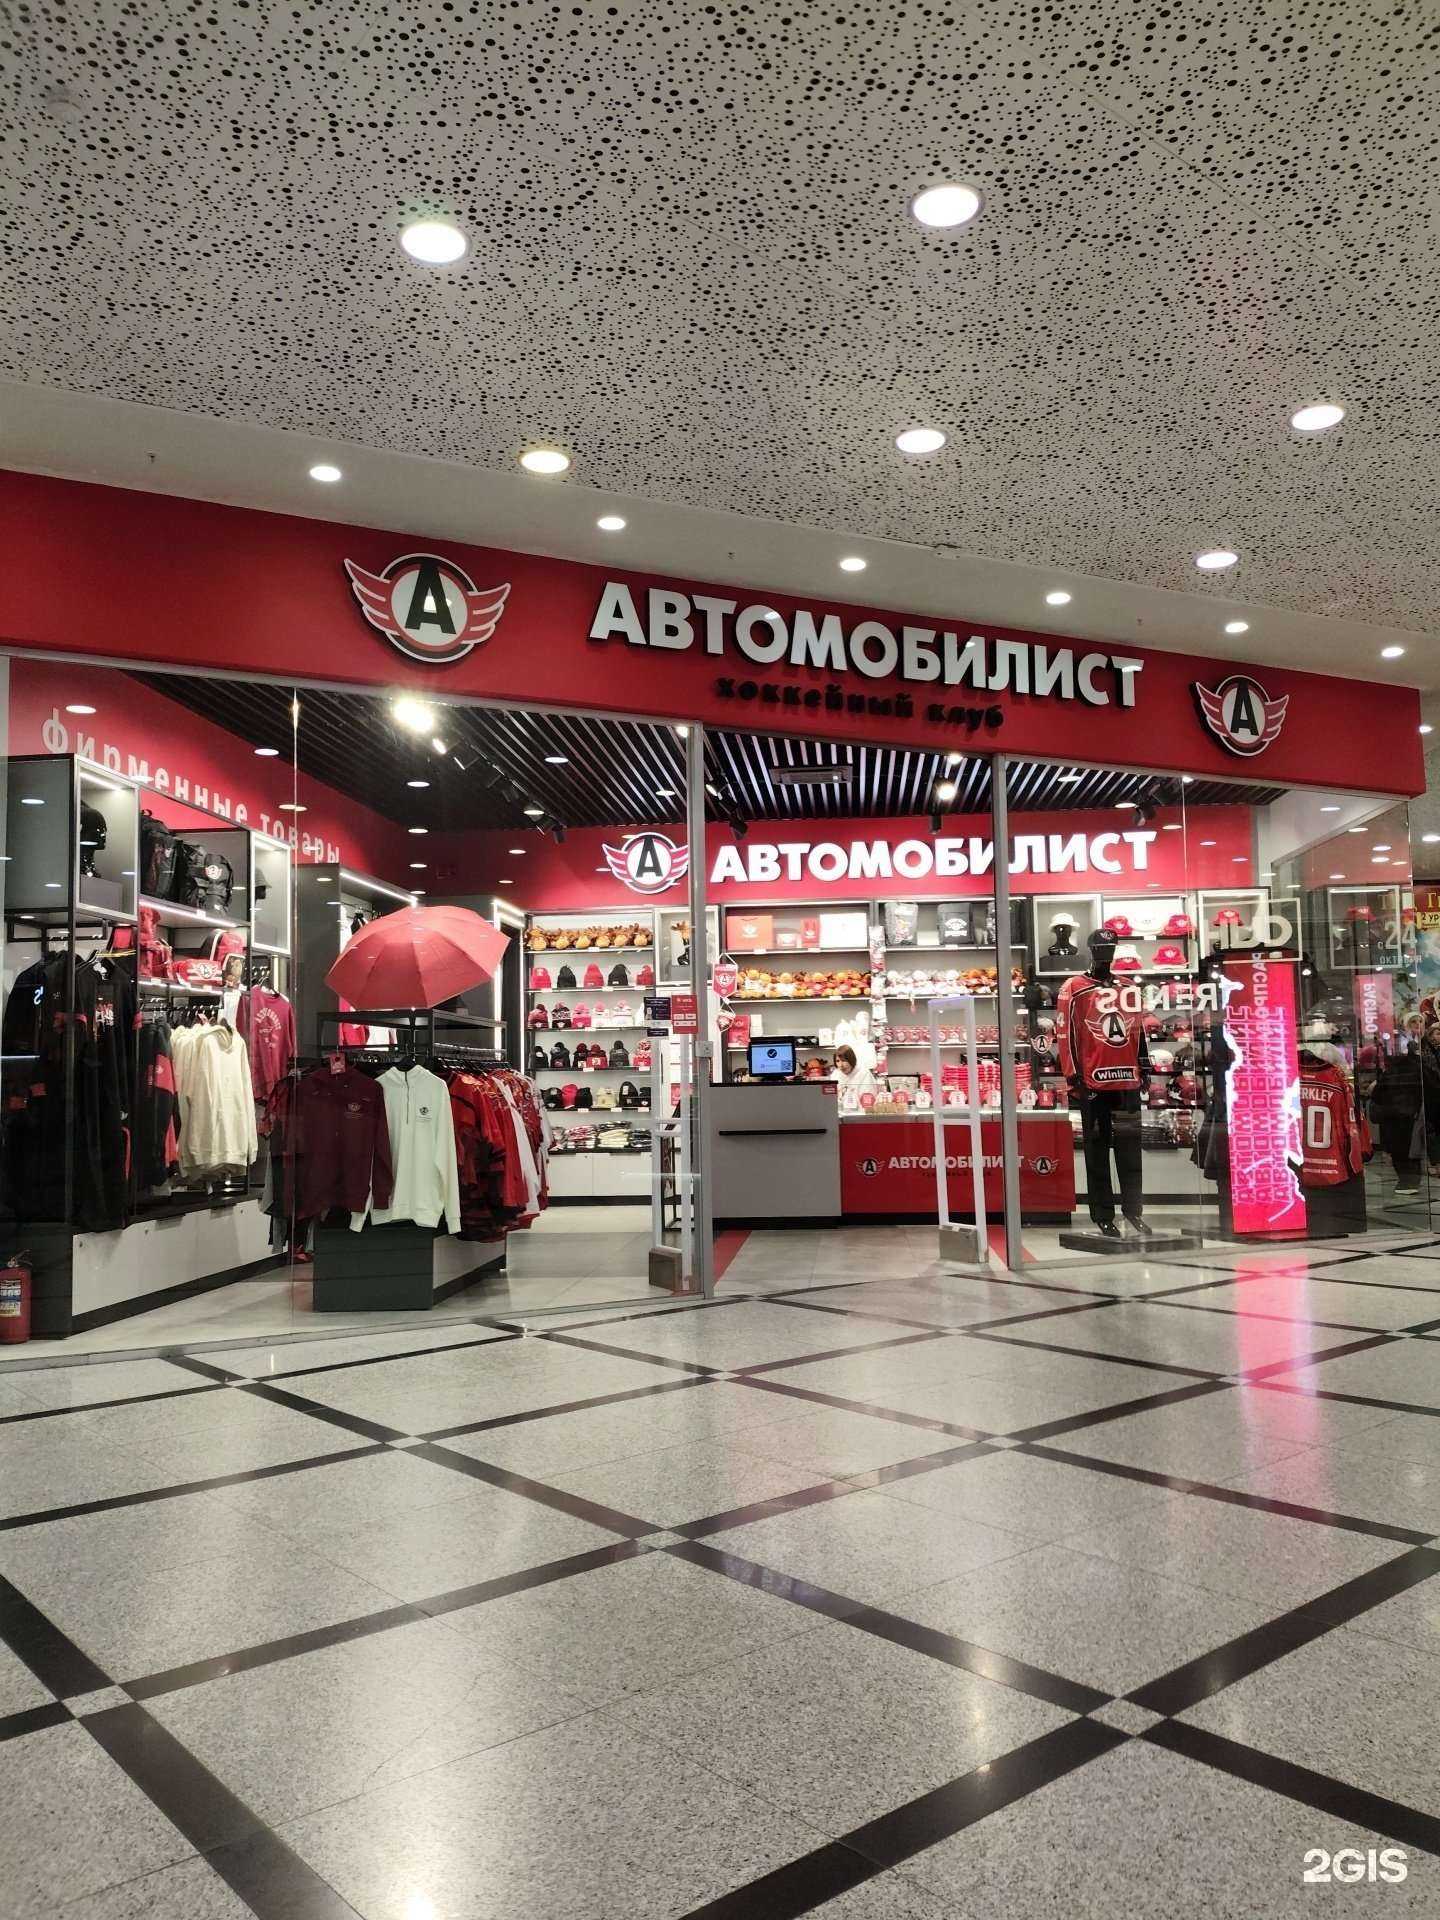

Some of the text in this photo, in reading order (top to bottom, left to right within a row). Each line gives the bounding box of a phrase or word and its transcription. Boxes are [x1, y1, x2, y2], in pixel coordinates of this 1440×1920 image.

[590, 581, 1145, 707] АВТОМОБИЛИСТ
[716, 678, 1004, 731] хоккейный клуб
[259, 813, 340, 864] товары
[710, 831, 1157, 883] АВТОМОБИЛИСТ
[1097, 1069, 1133, 1080] Winline
